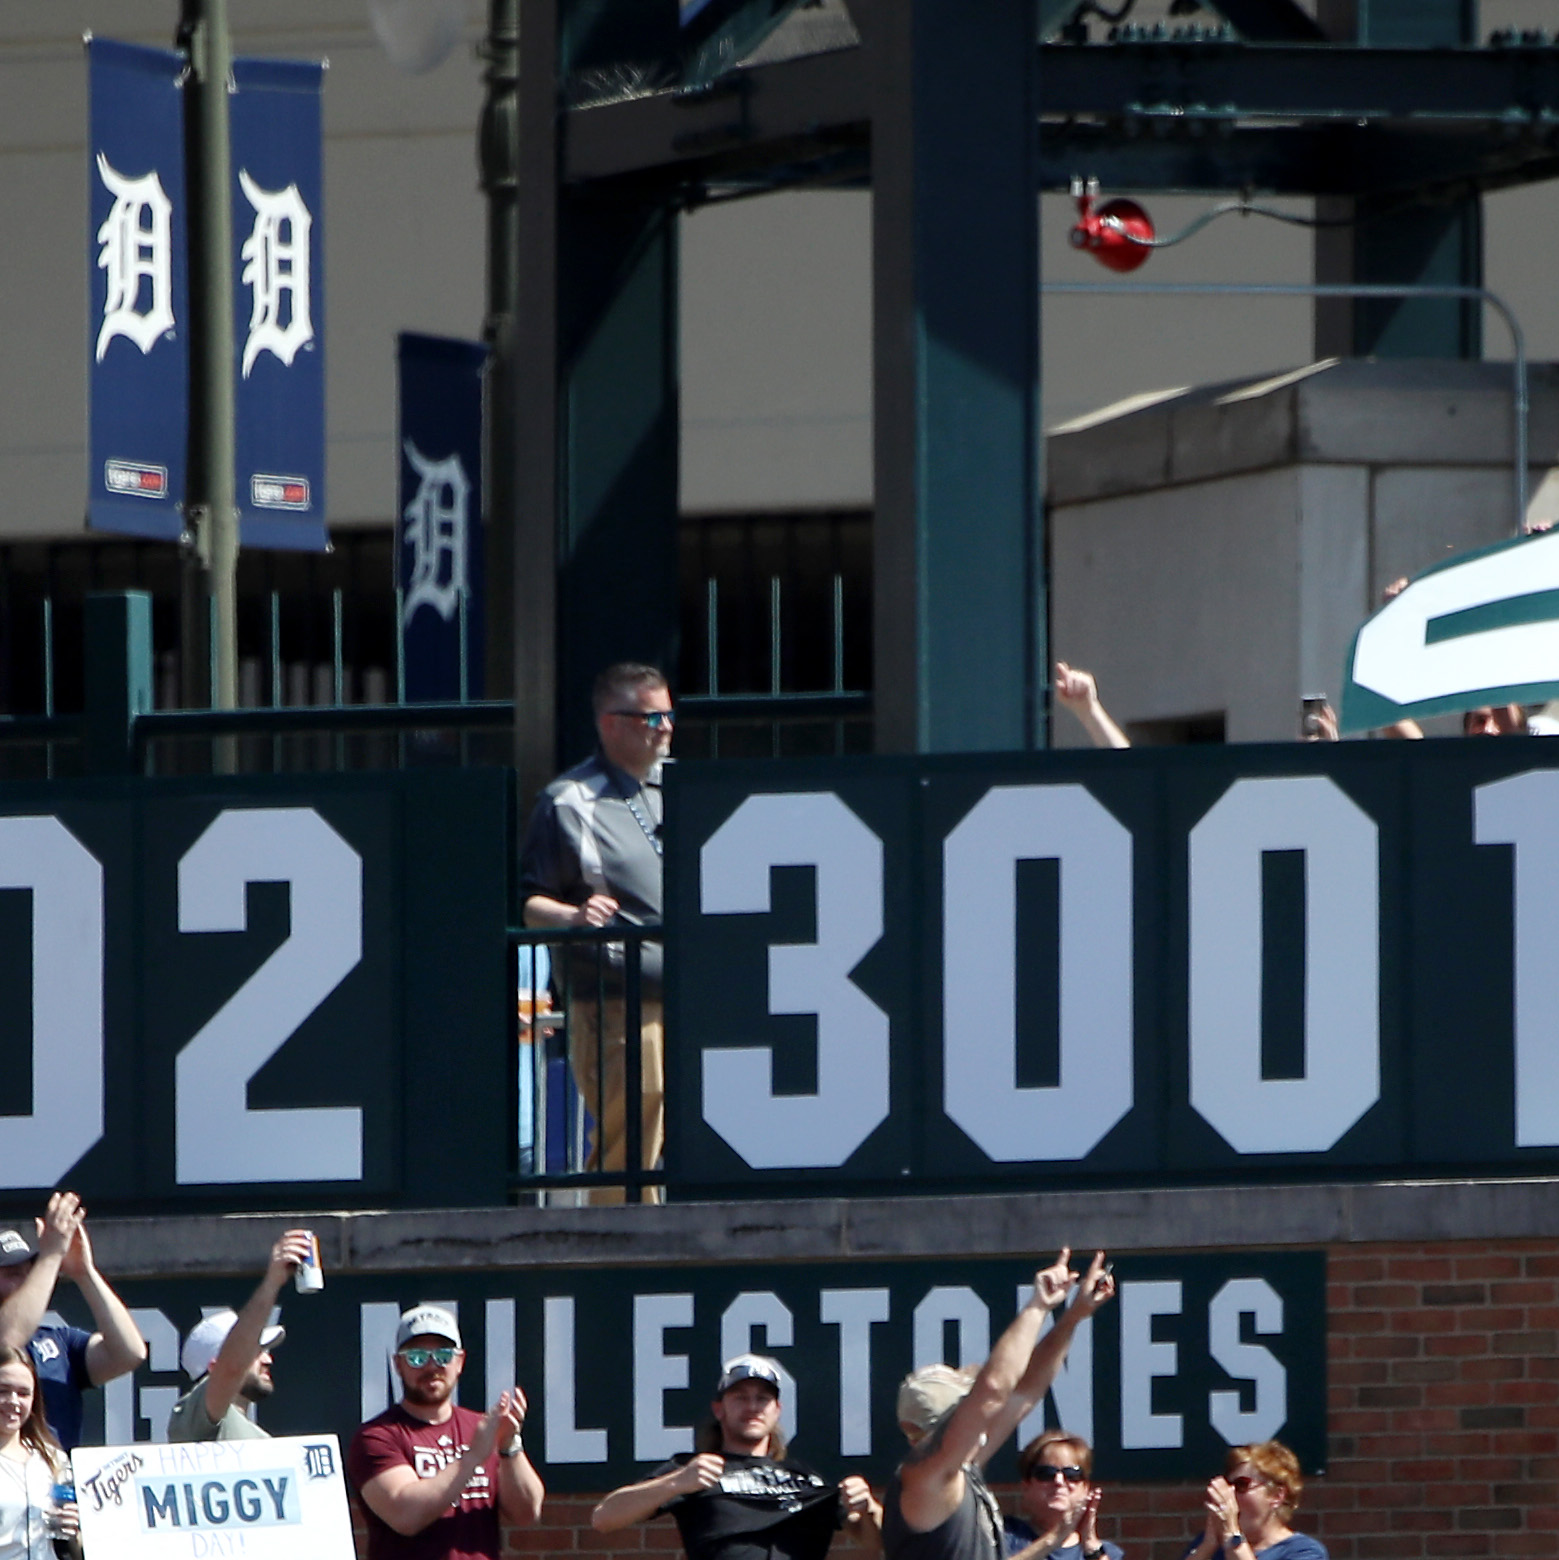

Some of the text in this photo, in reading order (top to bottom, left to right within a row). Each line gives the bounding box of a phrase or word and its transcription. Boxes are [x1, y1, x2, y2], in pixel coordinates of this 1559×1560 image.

[80, 1453, 145, 1512] Tigers
[158, 1441, 247, 1475] HAPPY
[140, 1475, 290, 1529] MIGGY
